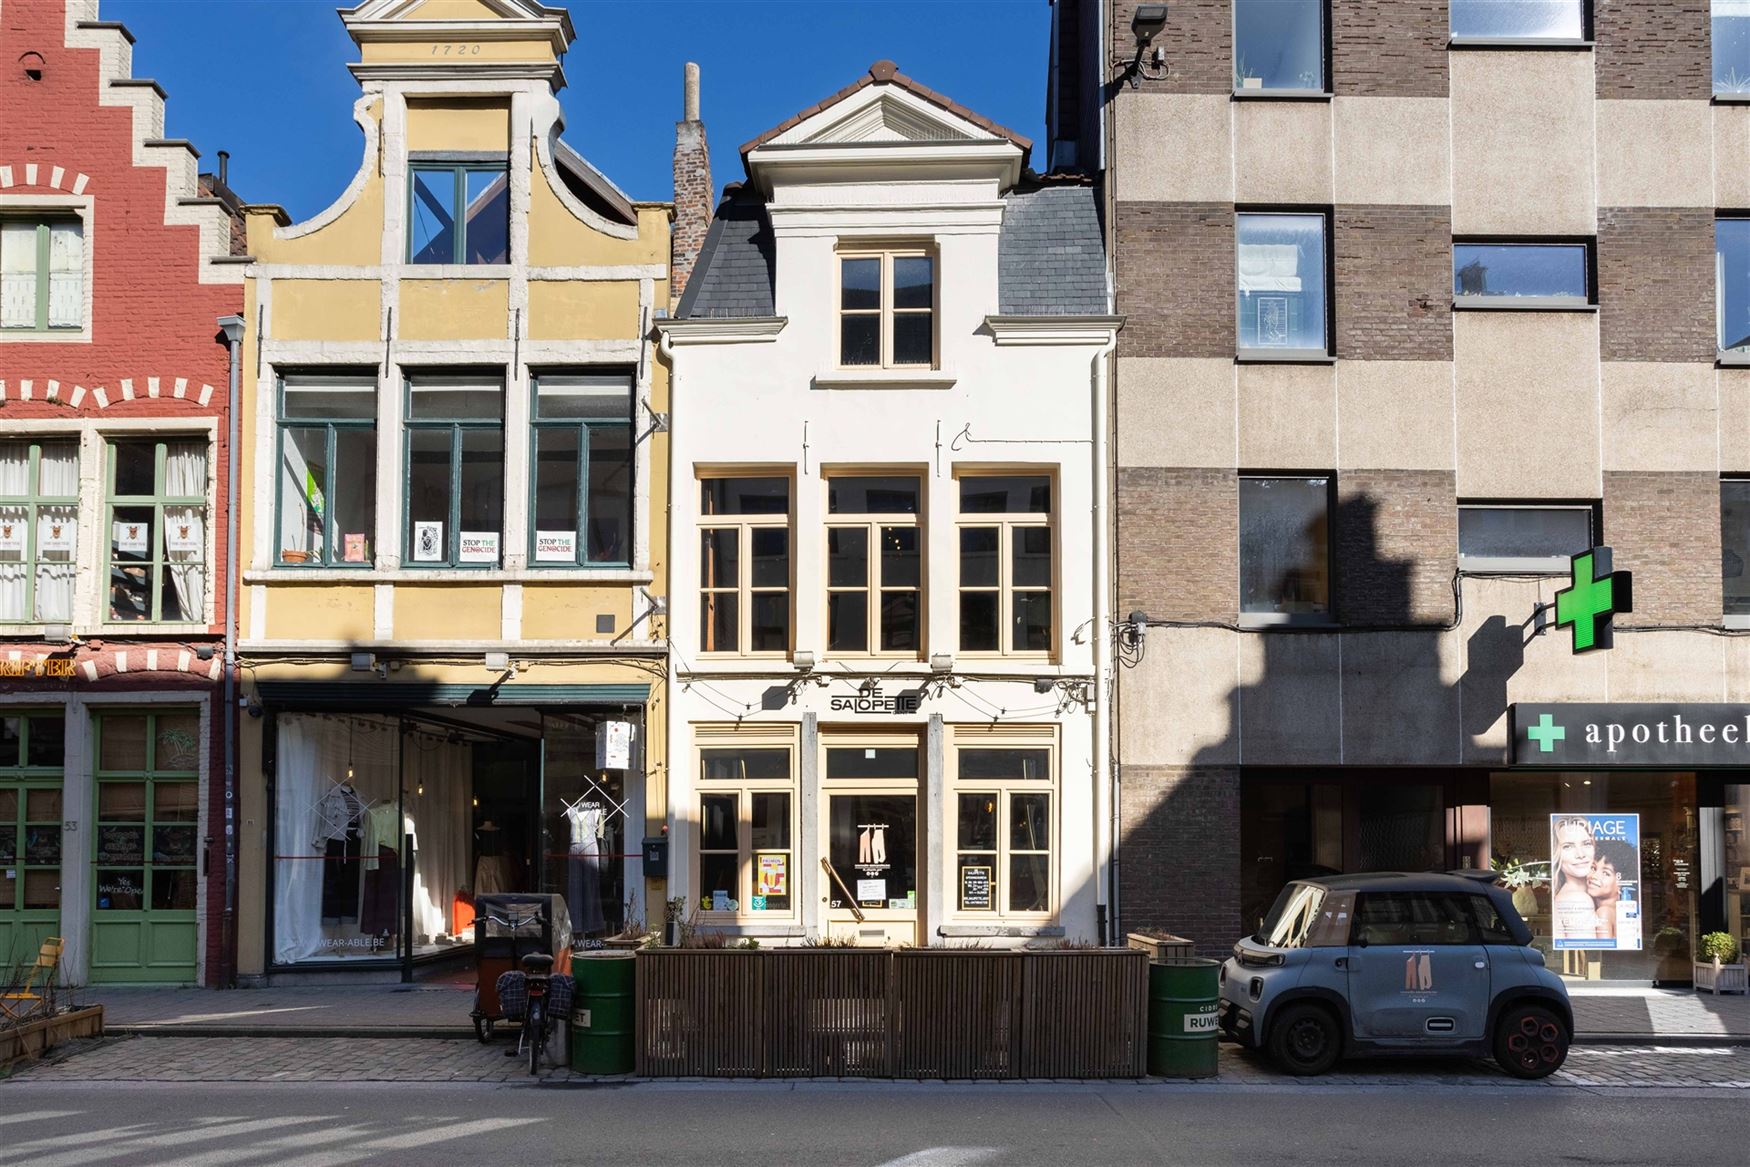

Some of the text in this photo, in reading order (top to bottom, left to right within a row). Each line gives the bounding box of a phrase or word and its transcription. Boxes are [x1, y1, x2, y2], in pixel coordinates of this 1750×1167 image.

[432, 45, 480, 55] 1720
[859, 688, 883, 698] DE
[831, 696, 917, 713] SALOPETTE
[64, 821, 78, 831] 53
[118, 877, 131, 886] Yes
[831, 900, 841, 908] 57
[302, 938, 385, 947] WEAR-ABLE.BE
[1190, 1016, 1218, 1028] RUWE
